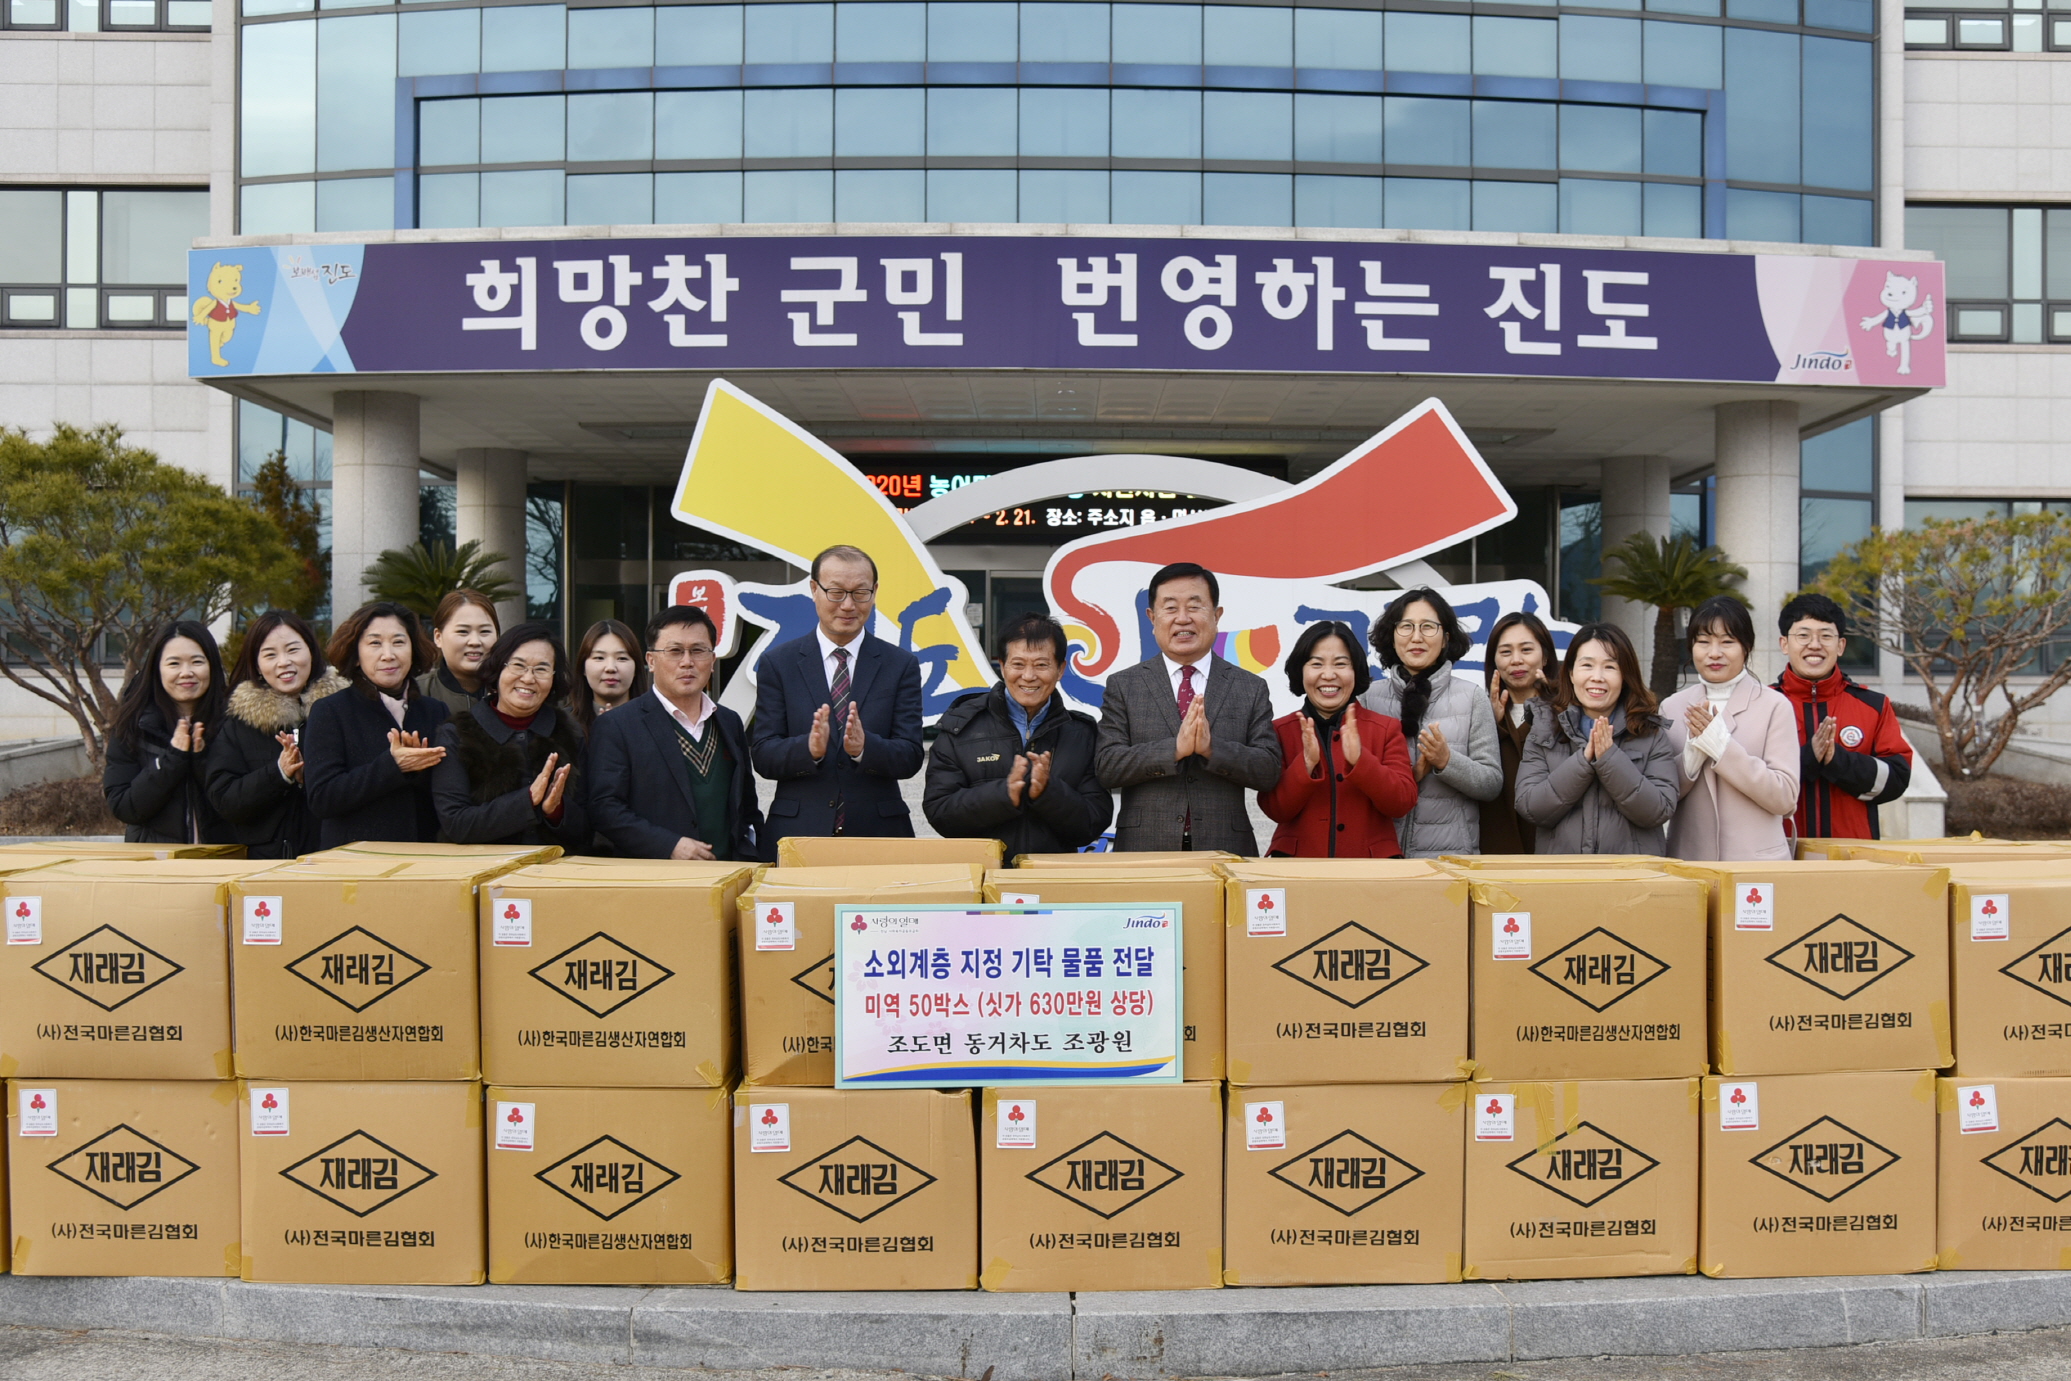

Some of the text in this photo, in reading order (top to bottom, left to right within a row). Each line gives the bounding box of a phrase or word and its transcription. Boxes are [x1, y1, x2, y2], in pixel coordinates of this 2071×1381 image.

[321, 263, 357, 285] 진도
[463, 253, 1657, 355] 희망찬 군민 번영하는 진도
[1790, 353, 1843, 370] Jindo
[866, 474, 923, 498] 20년
[1046, 508, 1082, 527] 장소:
[1087, 508, 1135, 527] 주소지
[1122, 917, 1161, 929] Jindo
[69, 953, 144, 984] 재래김
[321, 954, 393, 985] 재래김
[864, 948, 950, 979] 소외계층
[961, 949, 1001, 978] 지정
[1012, 948, 1053, 978] 기탁
[1062, 948, 1103, 977] 물품
[1113, 947, 1154, 976] 전달
[1313, 949, 1390, 981] 재래김
[1564, 954, 1634, 985] 재래김
[1804, 941, 1877, 973] 재래김
[564, 960, 636, 990] 재래김
[866, 990, 1152, 1018] 미역 50박스 (싯가 630만원 상당)
[888, 1031, 1132, 1054] 조도면 동거차도 조광원
[86, 1152, 161, 1182] 재래김
[320, 1158, 397, 1189] 재래김
[1309, 1158, 1385, 1188] 재래김
[1789, 1143, 1863, 1175] 재래김
[2019, 1145, 2071, 1176] 재래
[571, 1163, 642, 1193] 재래김
[819, 1164, 897, 1195] 재래김
[1067, 1159, 1144, 1191] 재래김
